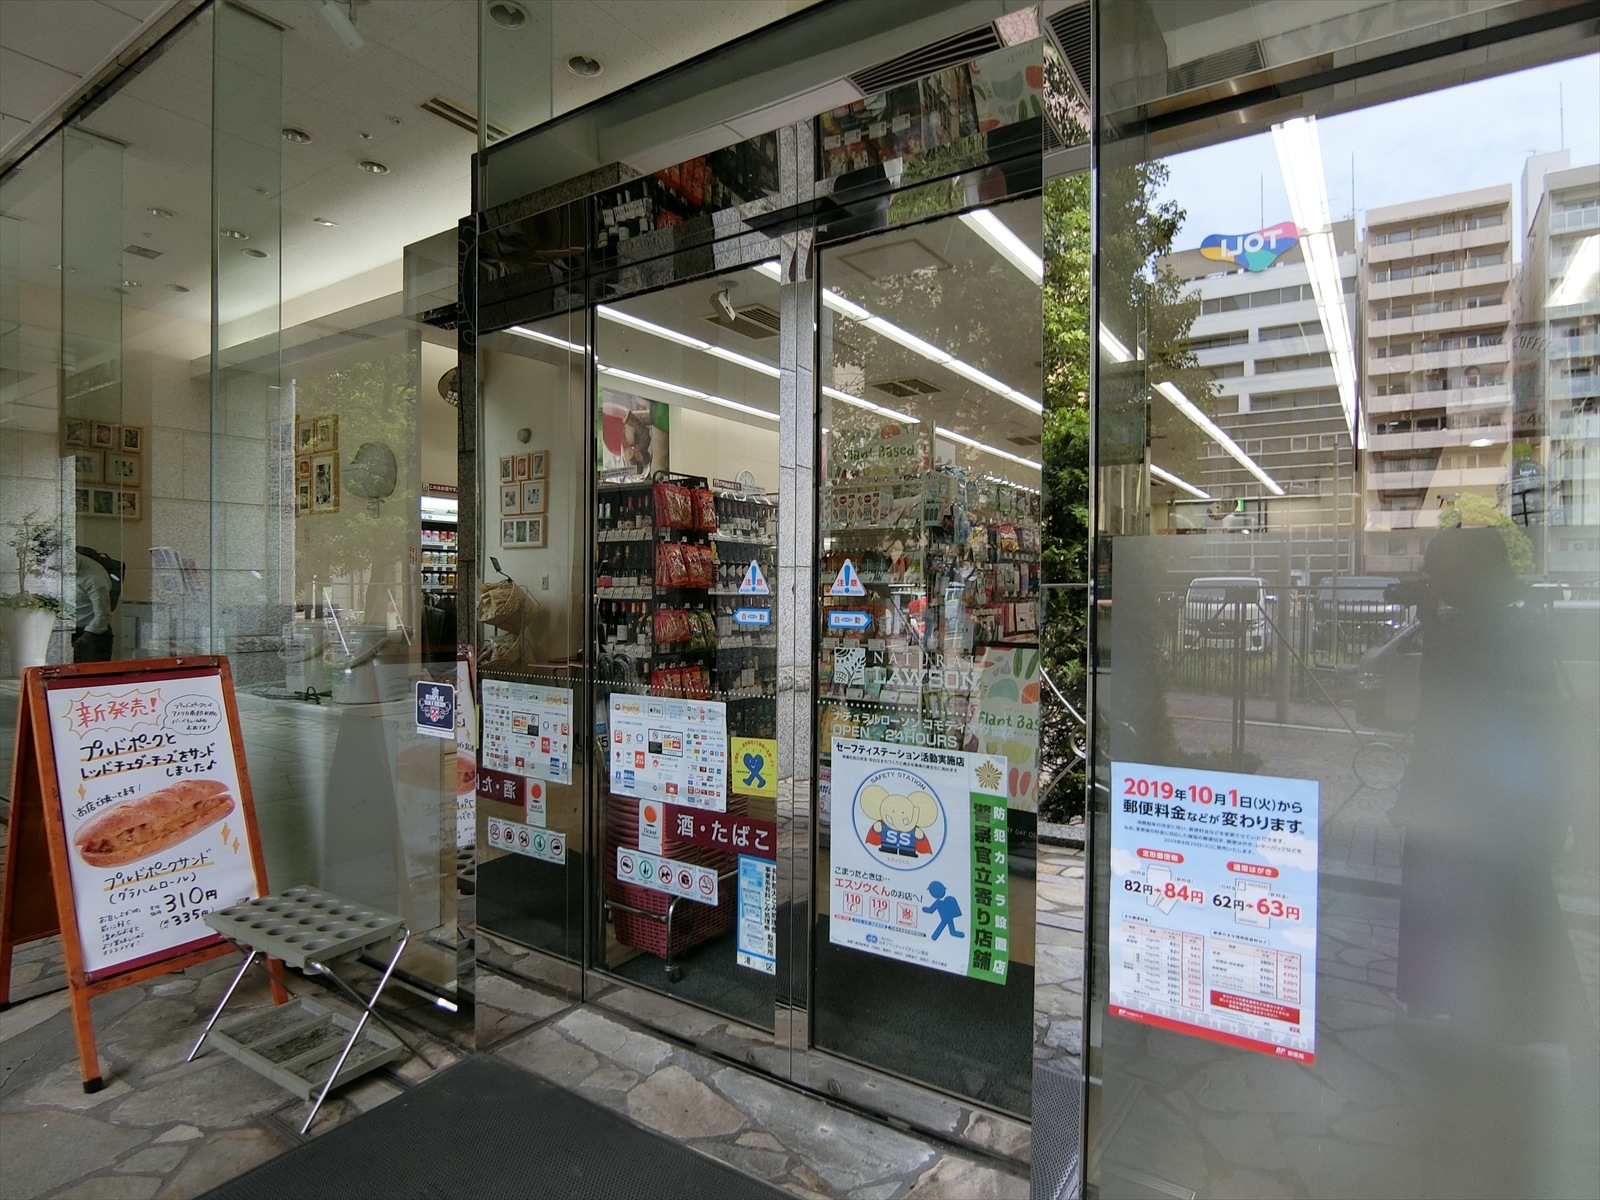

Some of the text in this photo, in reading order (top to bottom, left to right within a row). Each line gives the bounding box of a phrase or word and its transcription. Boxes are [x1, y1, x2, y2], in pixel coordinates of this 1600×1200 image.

[873, 651, 975, 668] NATURAL
[874, 666, 979, 691] LAWSON
[75, 697, 158, 728] 新発売!
[80, 733, 177, 762] プルドポークと
[833, 724, 958, 747] OPEN 24HOURS
[80, 742, 216, 779] レッドチェダーチーズをサンド
[836, 742, 965, 767] セーフティステーション活動実施店
[870, 771, 927, 791] SAFETY STATION
[1123, 777, 1303, 813] 2019年10月1日(火)から
[1123, 799, 1305, 835] 郵便料金などが変わります。
[643, 827, 658, 837] Ticket
[676, 813, 770, 851] 酒・たばこ
[104, 848, 212, 890] プルドポークサンド
[1233, 863, 1273, 876] 通常はがき
[163, 886, 218, 913] 310円
[844, 893, 861, 905] 110
[972, 802, 993, 971] 警察官立寄り店舗
[993, 806, 1008, 975] 防犯カメラ設置店
[1124, 879, 1204, 904] 82円 84円
[871, 898, 888, 910] 119
[1212, 893, 1300, 920] 62円 63円
